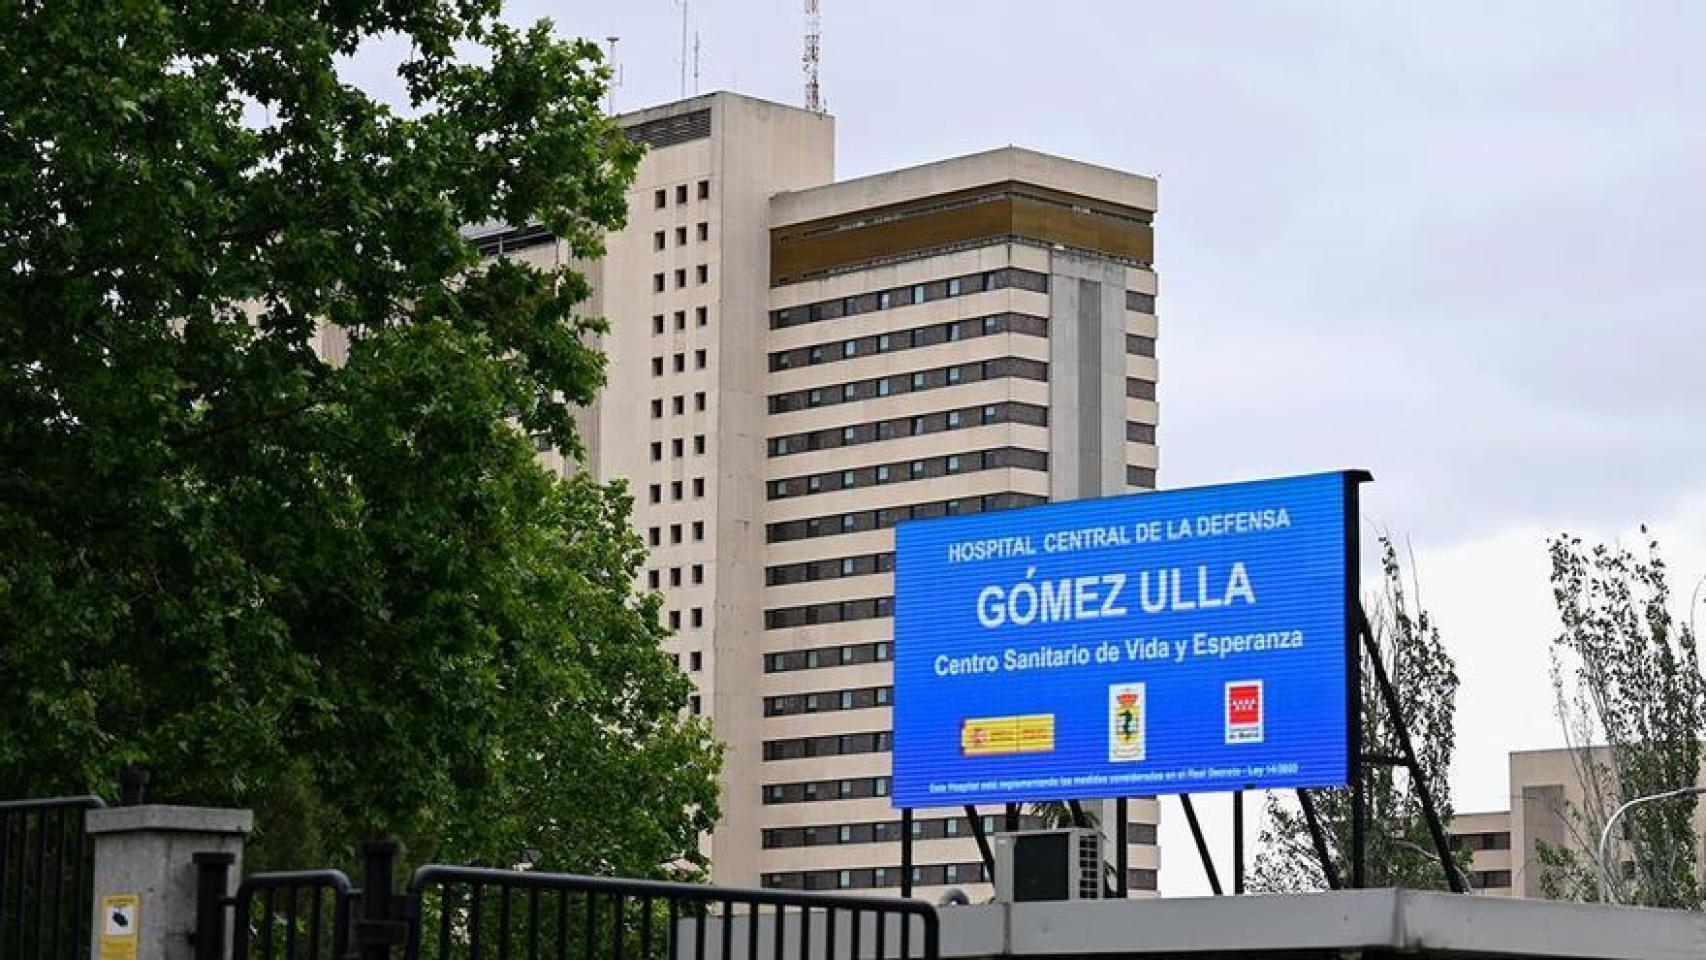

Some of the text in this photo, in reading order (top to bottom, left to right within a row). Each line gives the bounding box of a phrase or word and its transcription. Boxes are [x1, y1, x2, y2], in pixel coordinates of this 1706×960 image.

[949, 508, 1291, 562] HOSPITAL CENTRAL DE LA DEFENSA
[977, 562, 1256, 629] GÓMEZ ULLA
[934, 630, 1302, 677] Centro Sanitario de Vida y Esperanza
